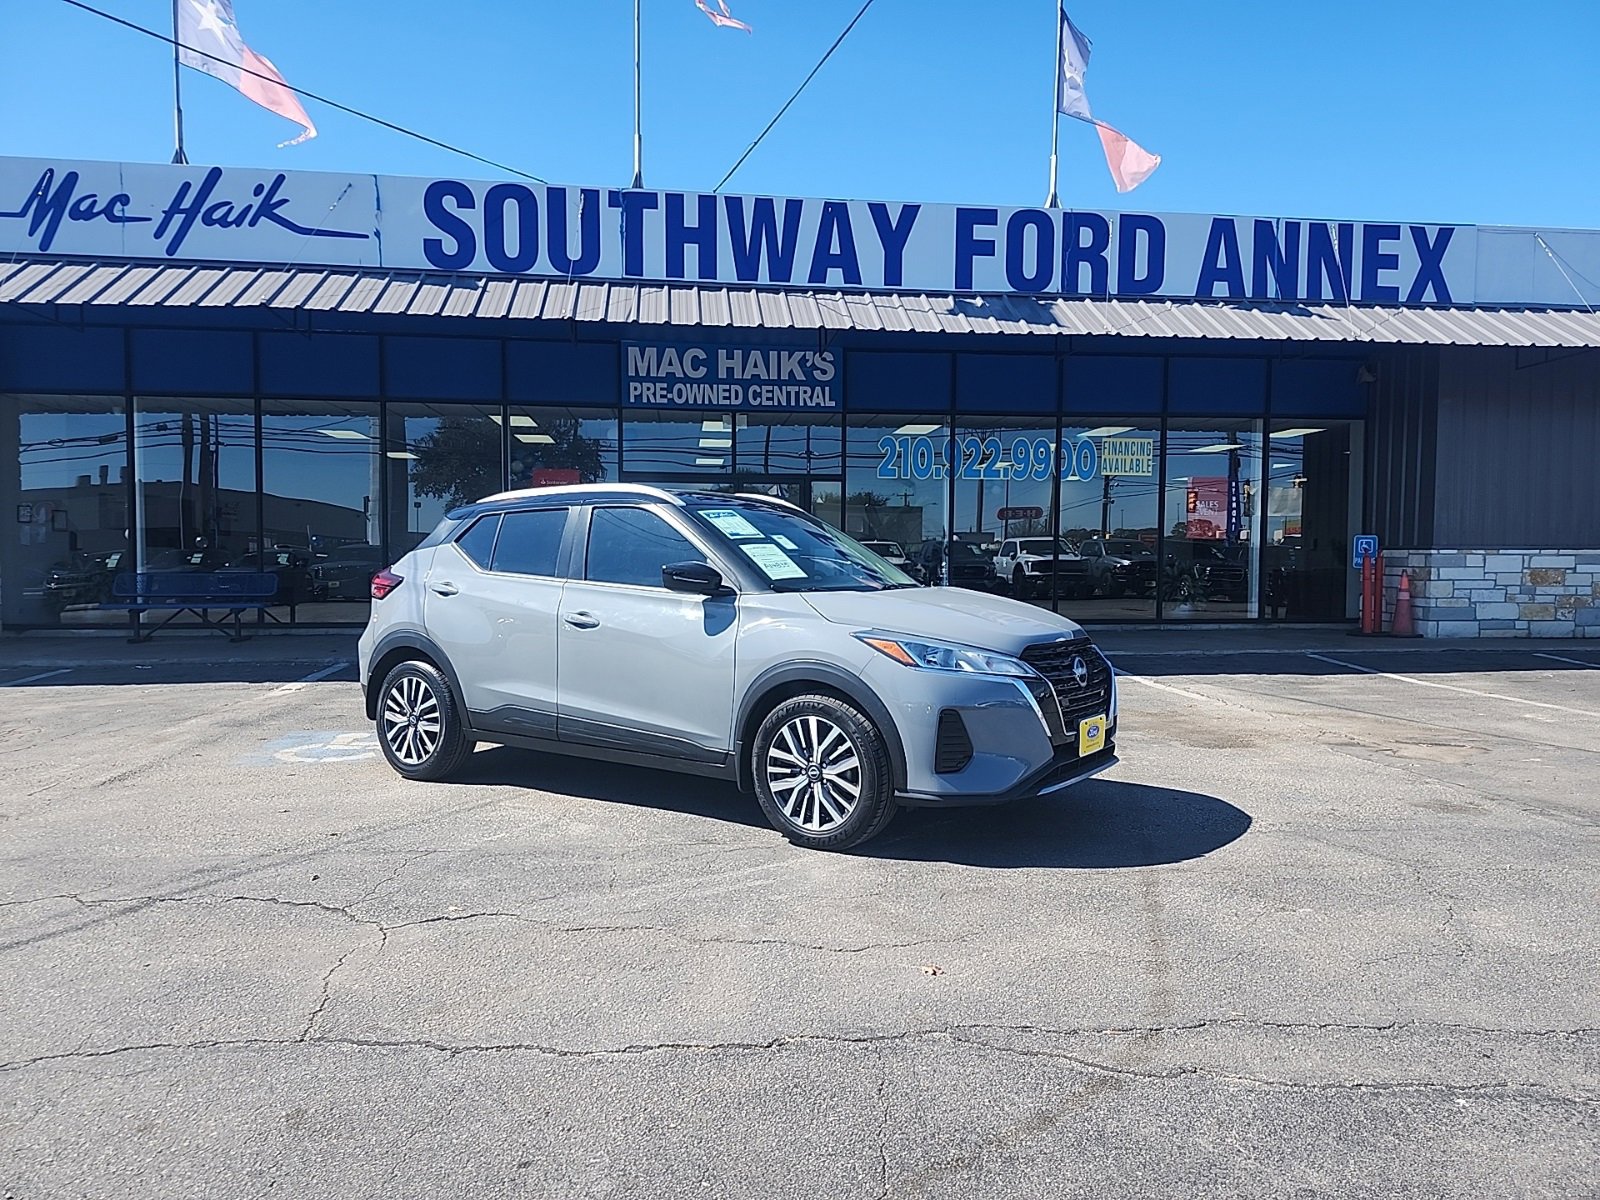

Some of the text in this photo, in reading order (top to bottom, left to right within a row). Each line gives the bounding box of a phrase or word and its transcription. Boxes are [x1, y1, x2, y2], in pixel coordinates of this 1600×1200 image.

[0, 166, 370, 257] Mac Haik
[423, 179, 1456, 304] SOUTHWAY FORD ANNEX
[628, 346, 836, 382] MAC HAIK'S
[630, 382, 836, 408] PRE-OWNED CENTRAL
[877, 436, 1098, 482] 210.922.9900
[1103, 440, 1152, 457] FINANCING
[1103, 457, 1152, 475] AVAILABLE
[1195, 500, 1219, 508] SALES
